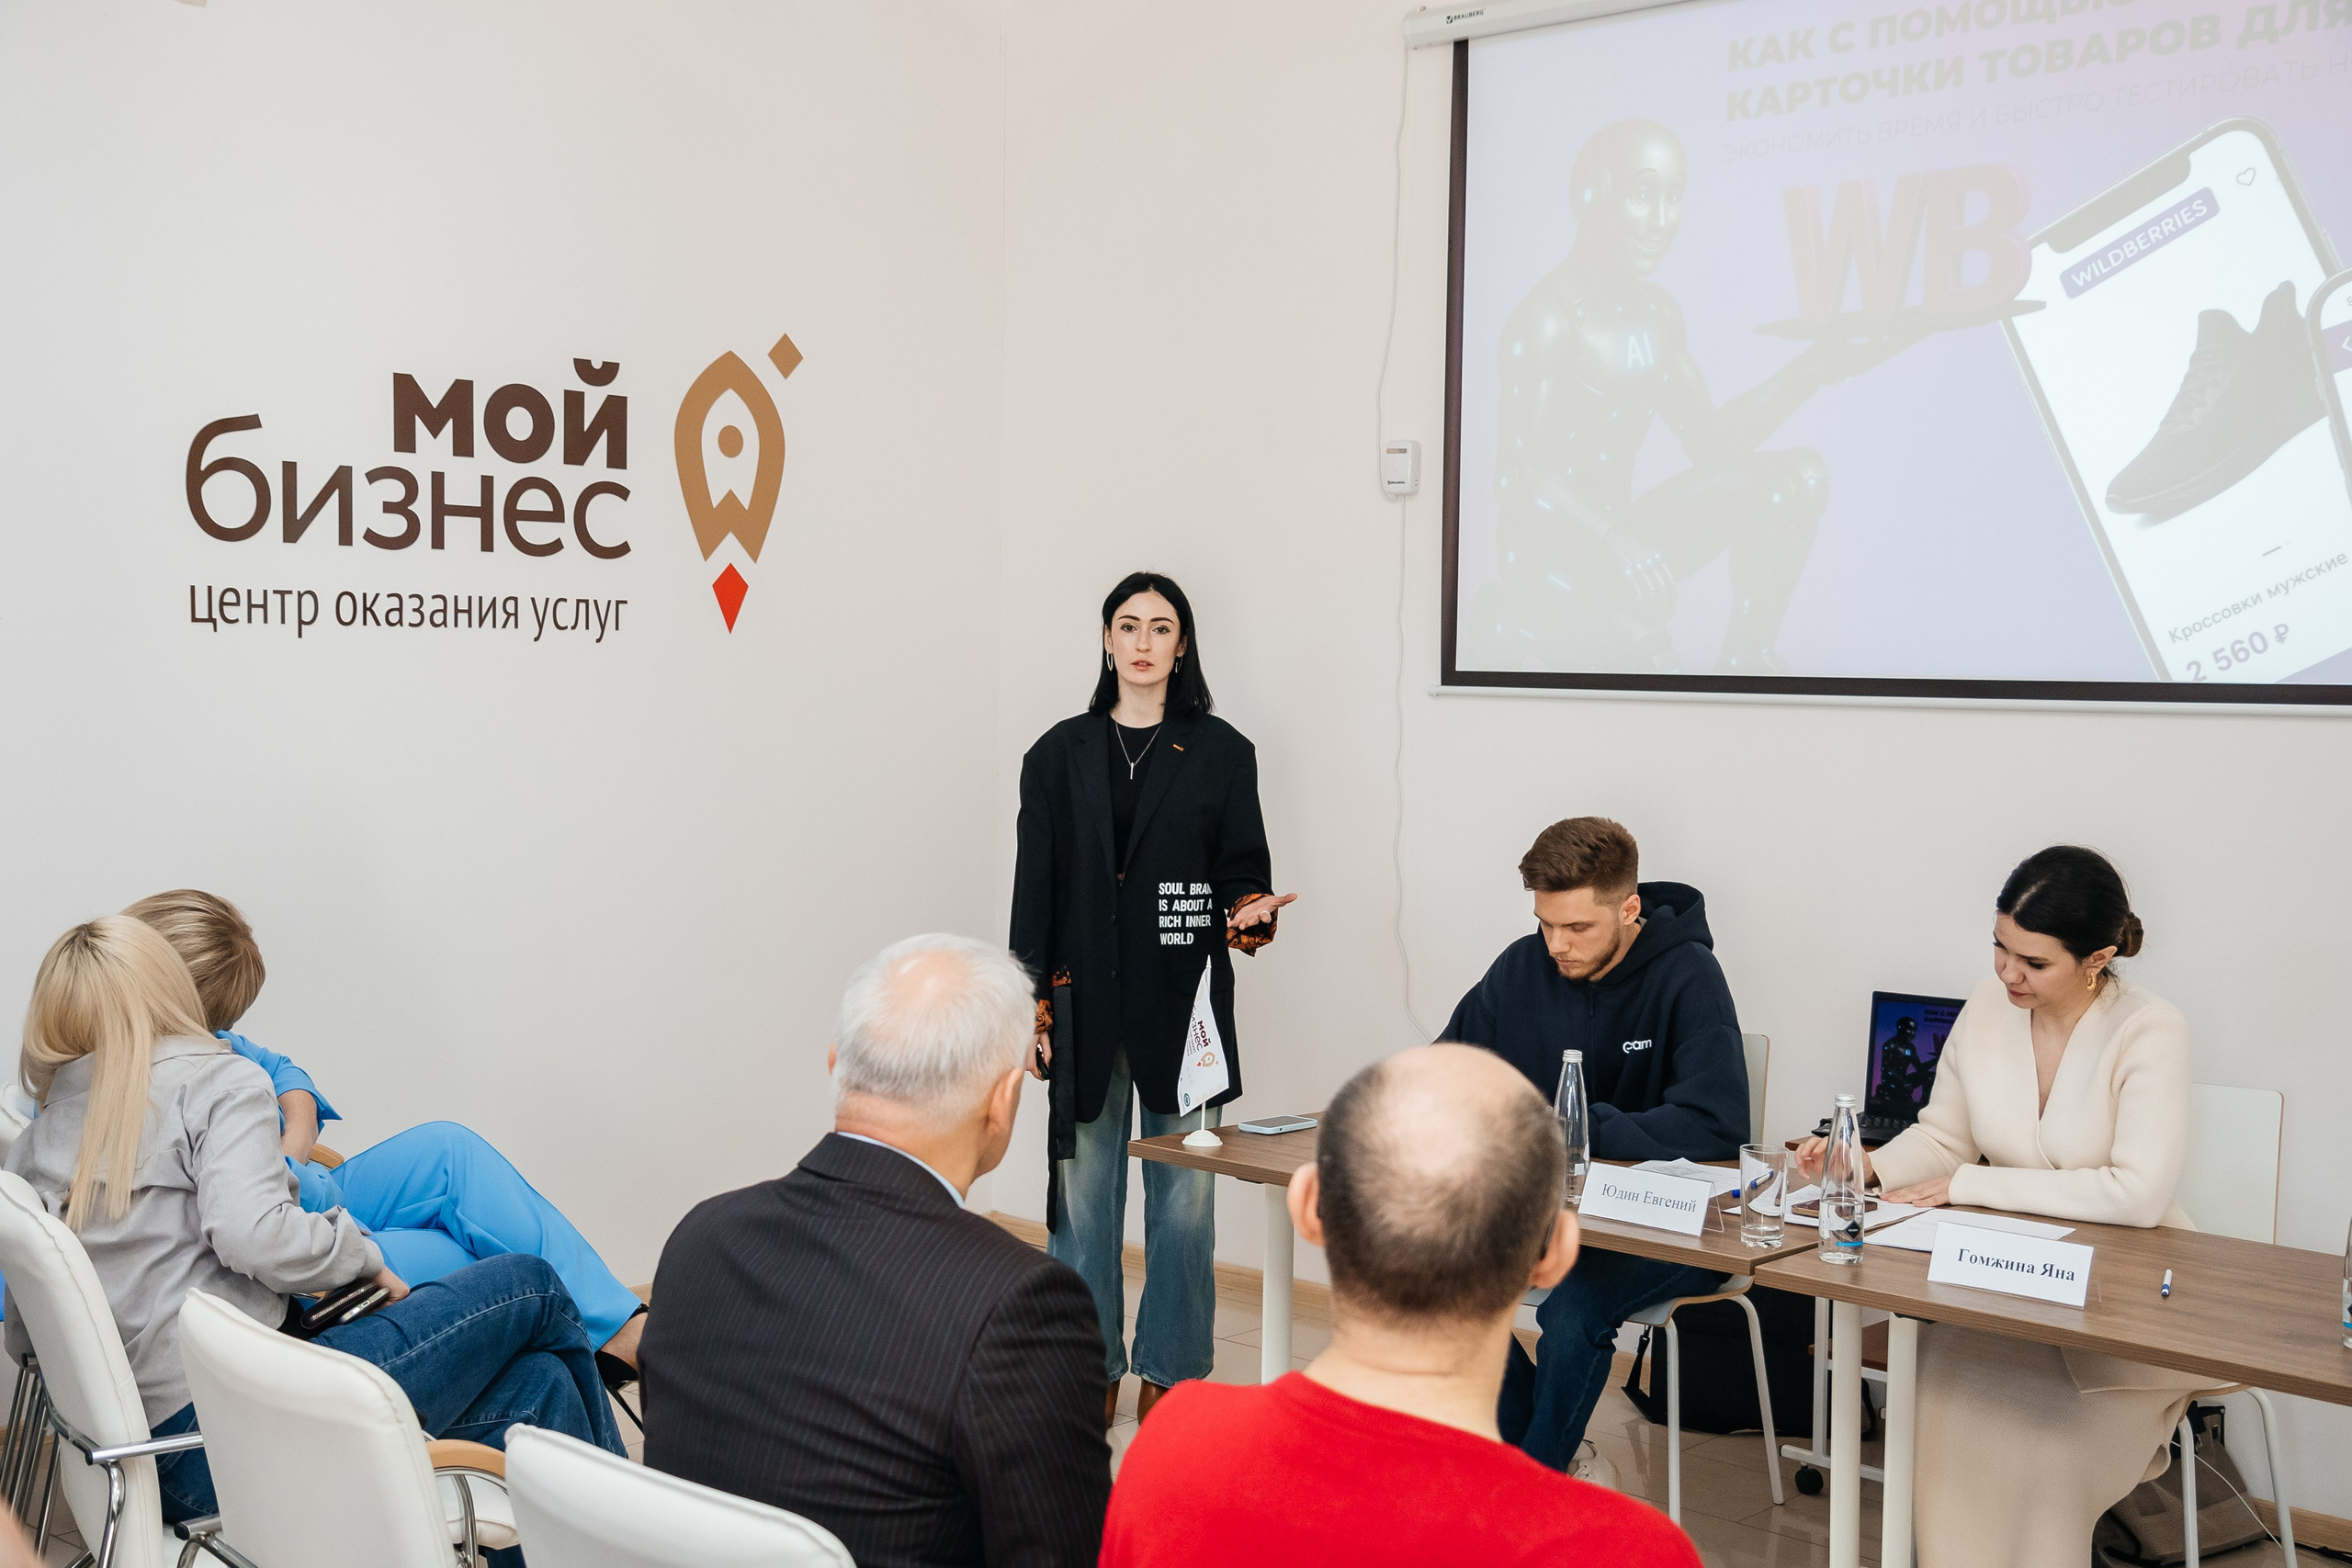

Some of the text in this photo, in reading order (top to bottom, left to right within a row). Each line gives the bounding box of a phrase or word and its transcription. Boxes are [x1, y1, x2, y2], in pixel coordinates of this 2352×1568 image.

[1453, 9, 1485, 20] BRAUBERG
[1728, 0, 2135, 72] КАК С ПОМОЩ
[1725, 0, 2352, 122] КАРТОЧКИ ТОВАРОВ ДЛЯ
[1723, 126, 1871, 163] ЭКОНОМИТЬ
[1878, 109, 1962, 141] ВРЕМЯ
[1970, 108, 1986, 129] И
[1996, 91, 2104, 126] БЫСТРО
[2111, 59, 2317, 107] ТЕСТИРОВАТЬ
[1782, 163, 2033, 322] WB
[2070, 198, 2208, 288] WILDBERRIES
[1626, 332, 1655, 368] AI
[392, 357, 628, 470] мой
[185, 413, 632, 560] бизнес
[189, 585, 628, 644] центр оказания услуг
[2168, 553, 2348, 644] Кроссовки мужские
[2186, 660, 2208, 682] 2
[2211, 631, 2268, 671] 560
[1159, 882, 1185, 895] SOUL
[1159, 899, 1168, 911] IS
[1172, 899, 1204, 911] ABOUT
[1159, 915, 1211, 928] RICH INNER
[1159, 932, 1194, 945] WORLD
[1601, 1183, 1697, 1213] Юдин Евгений
[1957, 1247, 2075, 1281] Гомжина Яна
